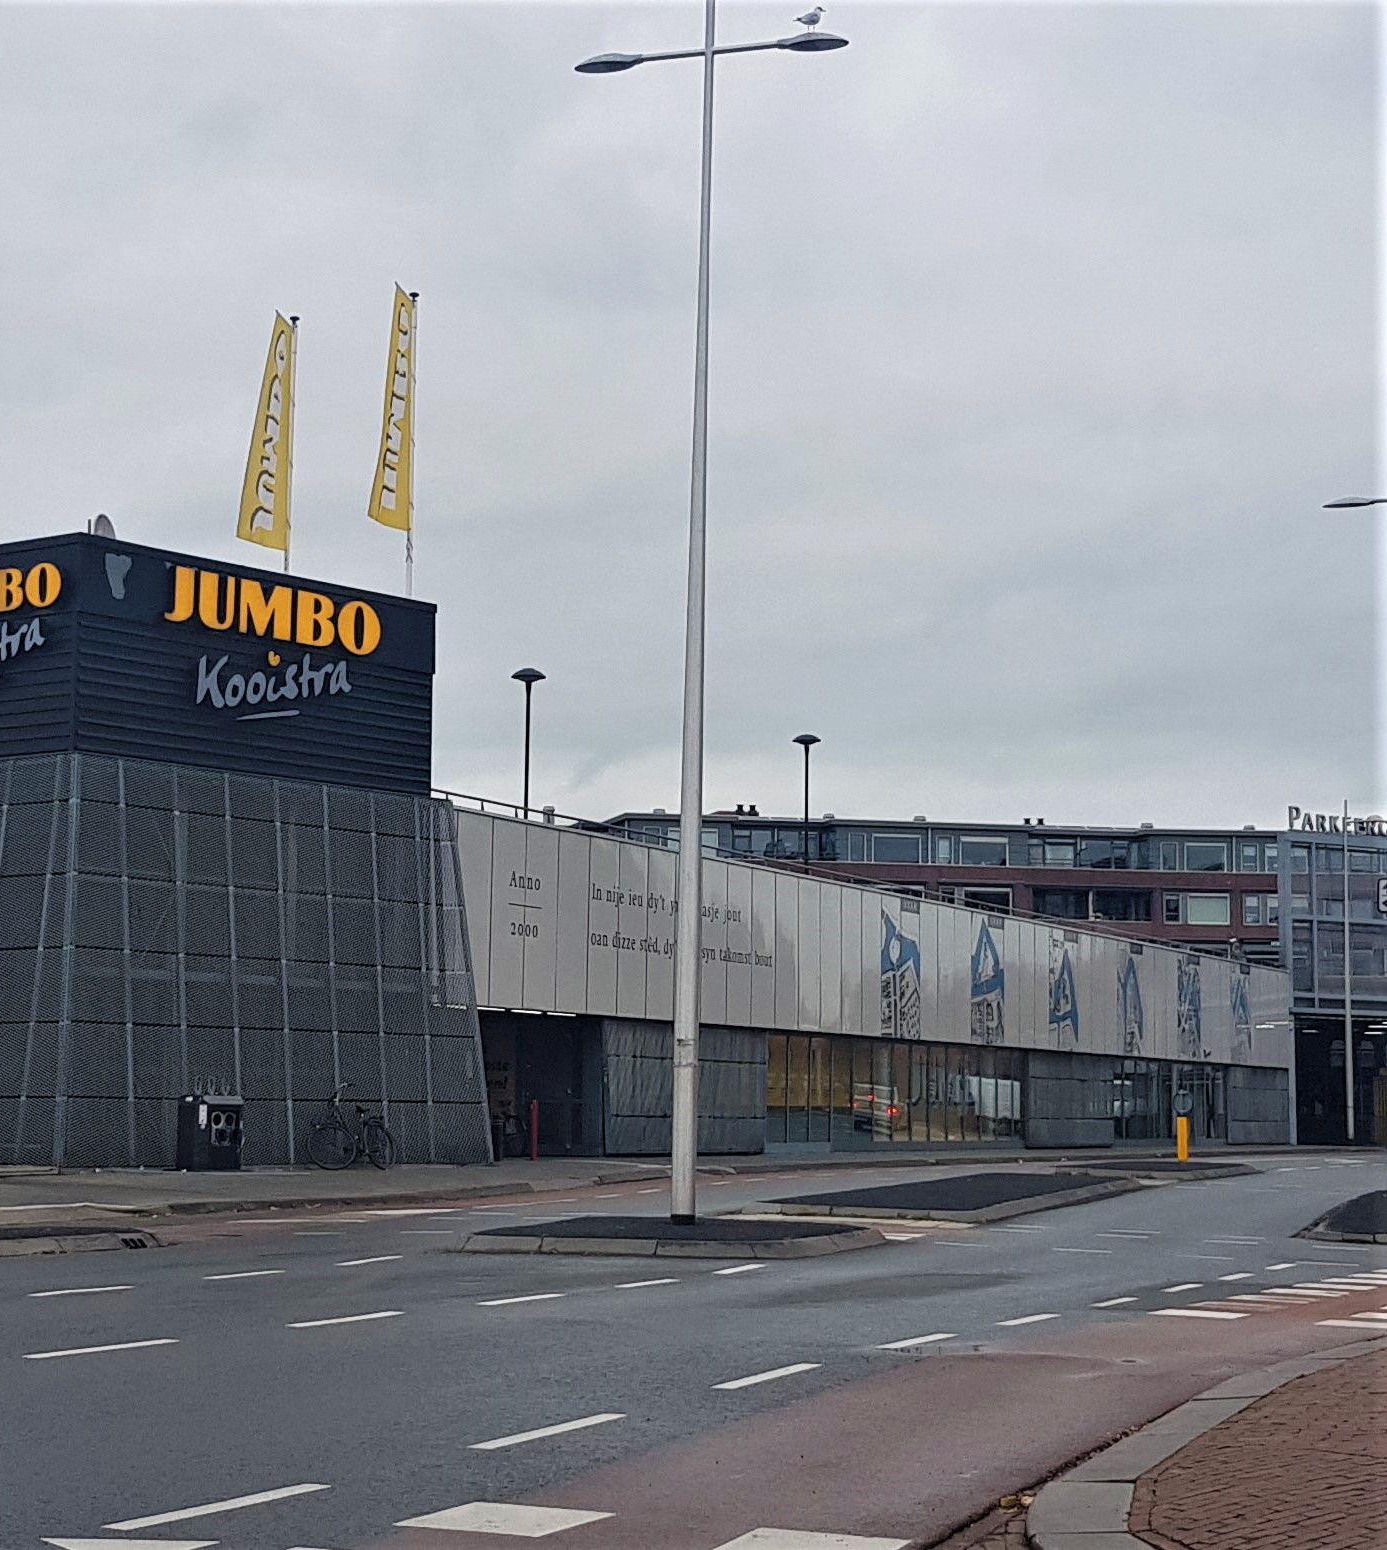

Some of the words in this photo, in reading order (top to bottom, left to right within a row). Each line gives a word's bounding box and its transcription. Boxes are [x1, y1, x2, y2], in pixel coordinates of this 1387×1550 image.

[250, 329, 287, 533] JUMBO
[164, 565, 381, 656] JUMBO
[196, 650, 353, 709] Kooistra
[509, 870, 541, 891] Anno
[592, 883, 602, 900] In
[605, 884, 625, 907] nije
[647, 892, 665, 914] dy't
[510, 922, 539, 938] 2000
[591, 932, 609, 946] oan
[612, 931, 636, 951] dizze
